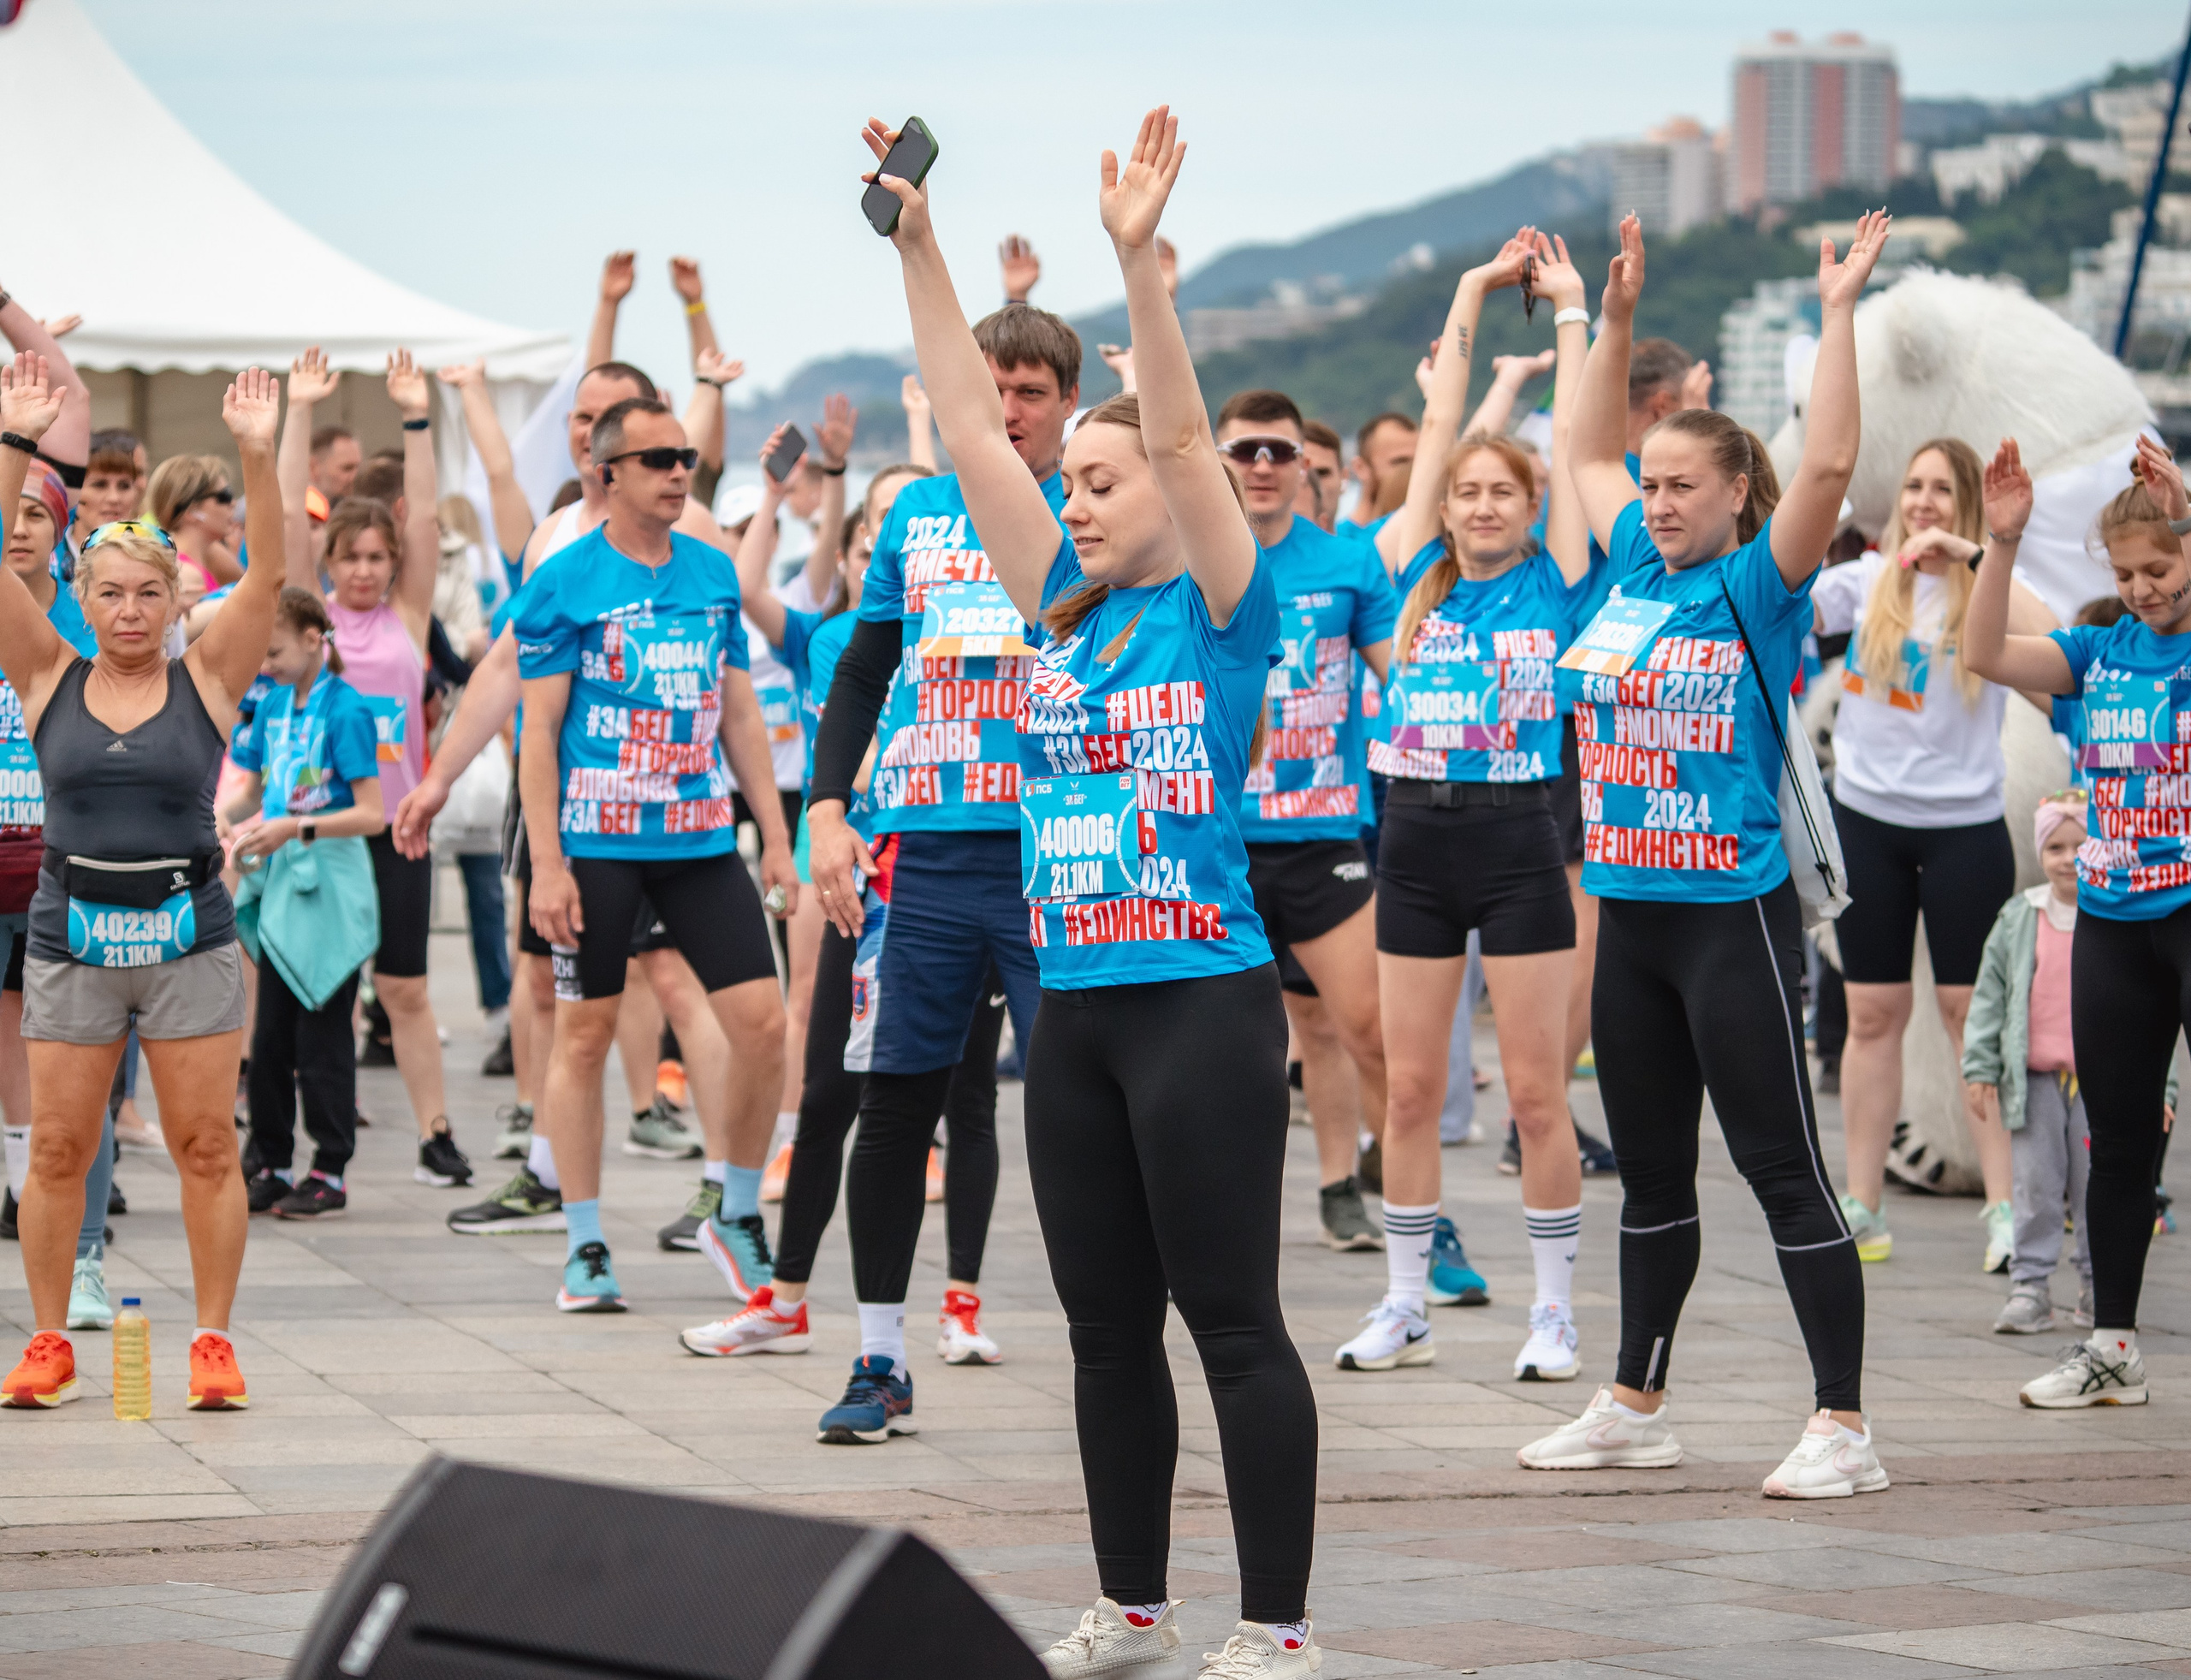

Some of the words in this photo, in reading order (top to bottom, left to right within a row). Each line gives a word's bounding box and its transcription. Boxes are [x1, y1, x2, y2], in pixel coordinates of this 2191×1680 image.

[901, 514, 966, 553] 2024
[945, 607, 1024, 633] 20327
[644, 641, 705, 670] 40044
[1493, 629, 1557, 659] #ЦЕЛЬ
[1647, 636, 1745, 674] #ЦЕЛЬ
[654, 671, 701, 696] 21.1KM
[917, 679, 1026, 722] #ГОРДО
[1582, 669, 1736, 713] #ЗАБЕГ2024
[586, 704, 672, 741] #ЗАБЕГ
[1105, 681, 1206, 733] #ЦЕЛЬ
[1409, 691, 1478, 721] 30034
[2091, 707, 2146, 740] 30146
[1421, 724, 1464, 750] 10KM
[1613, 704, 1734, 753] #МОМЕНТ
[1043, 726, 1209, 774] #ЗАБЕГ2024
[1487, 751, 1545, 783] 2024
[2099, 742, 2135, 769] 10KM
[874, 764, 941, 810] #ЗАБЕГ
[1036, 784, 1053, 794] ПСБ
[0, 801, 44, 824] 1.1KM
[560, 800, 641, 835] #ЗАБЕГ
[1643, 788, 1713, 832] 2024
[1040, 813, 1114, 858] 40006
[1585, 822, 1739, 870] #ЕДИНСТВО
[1050, 860, 1104, 897] 21.1KM
[1137, 856, 1192, 899] 024
[92, 911, 171, 942] 40239
[1063, 899, 1229, 947] #ЕДИНСТВО
[103, 944, 162, 969] 21.1KM
